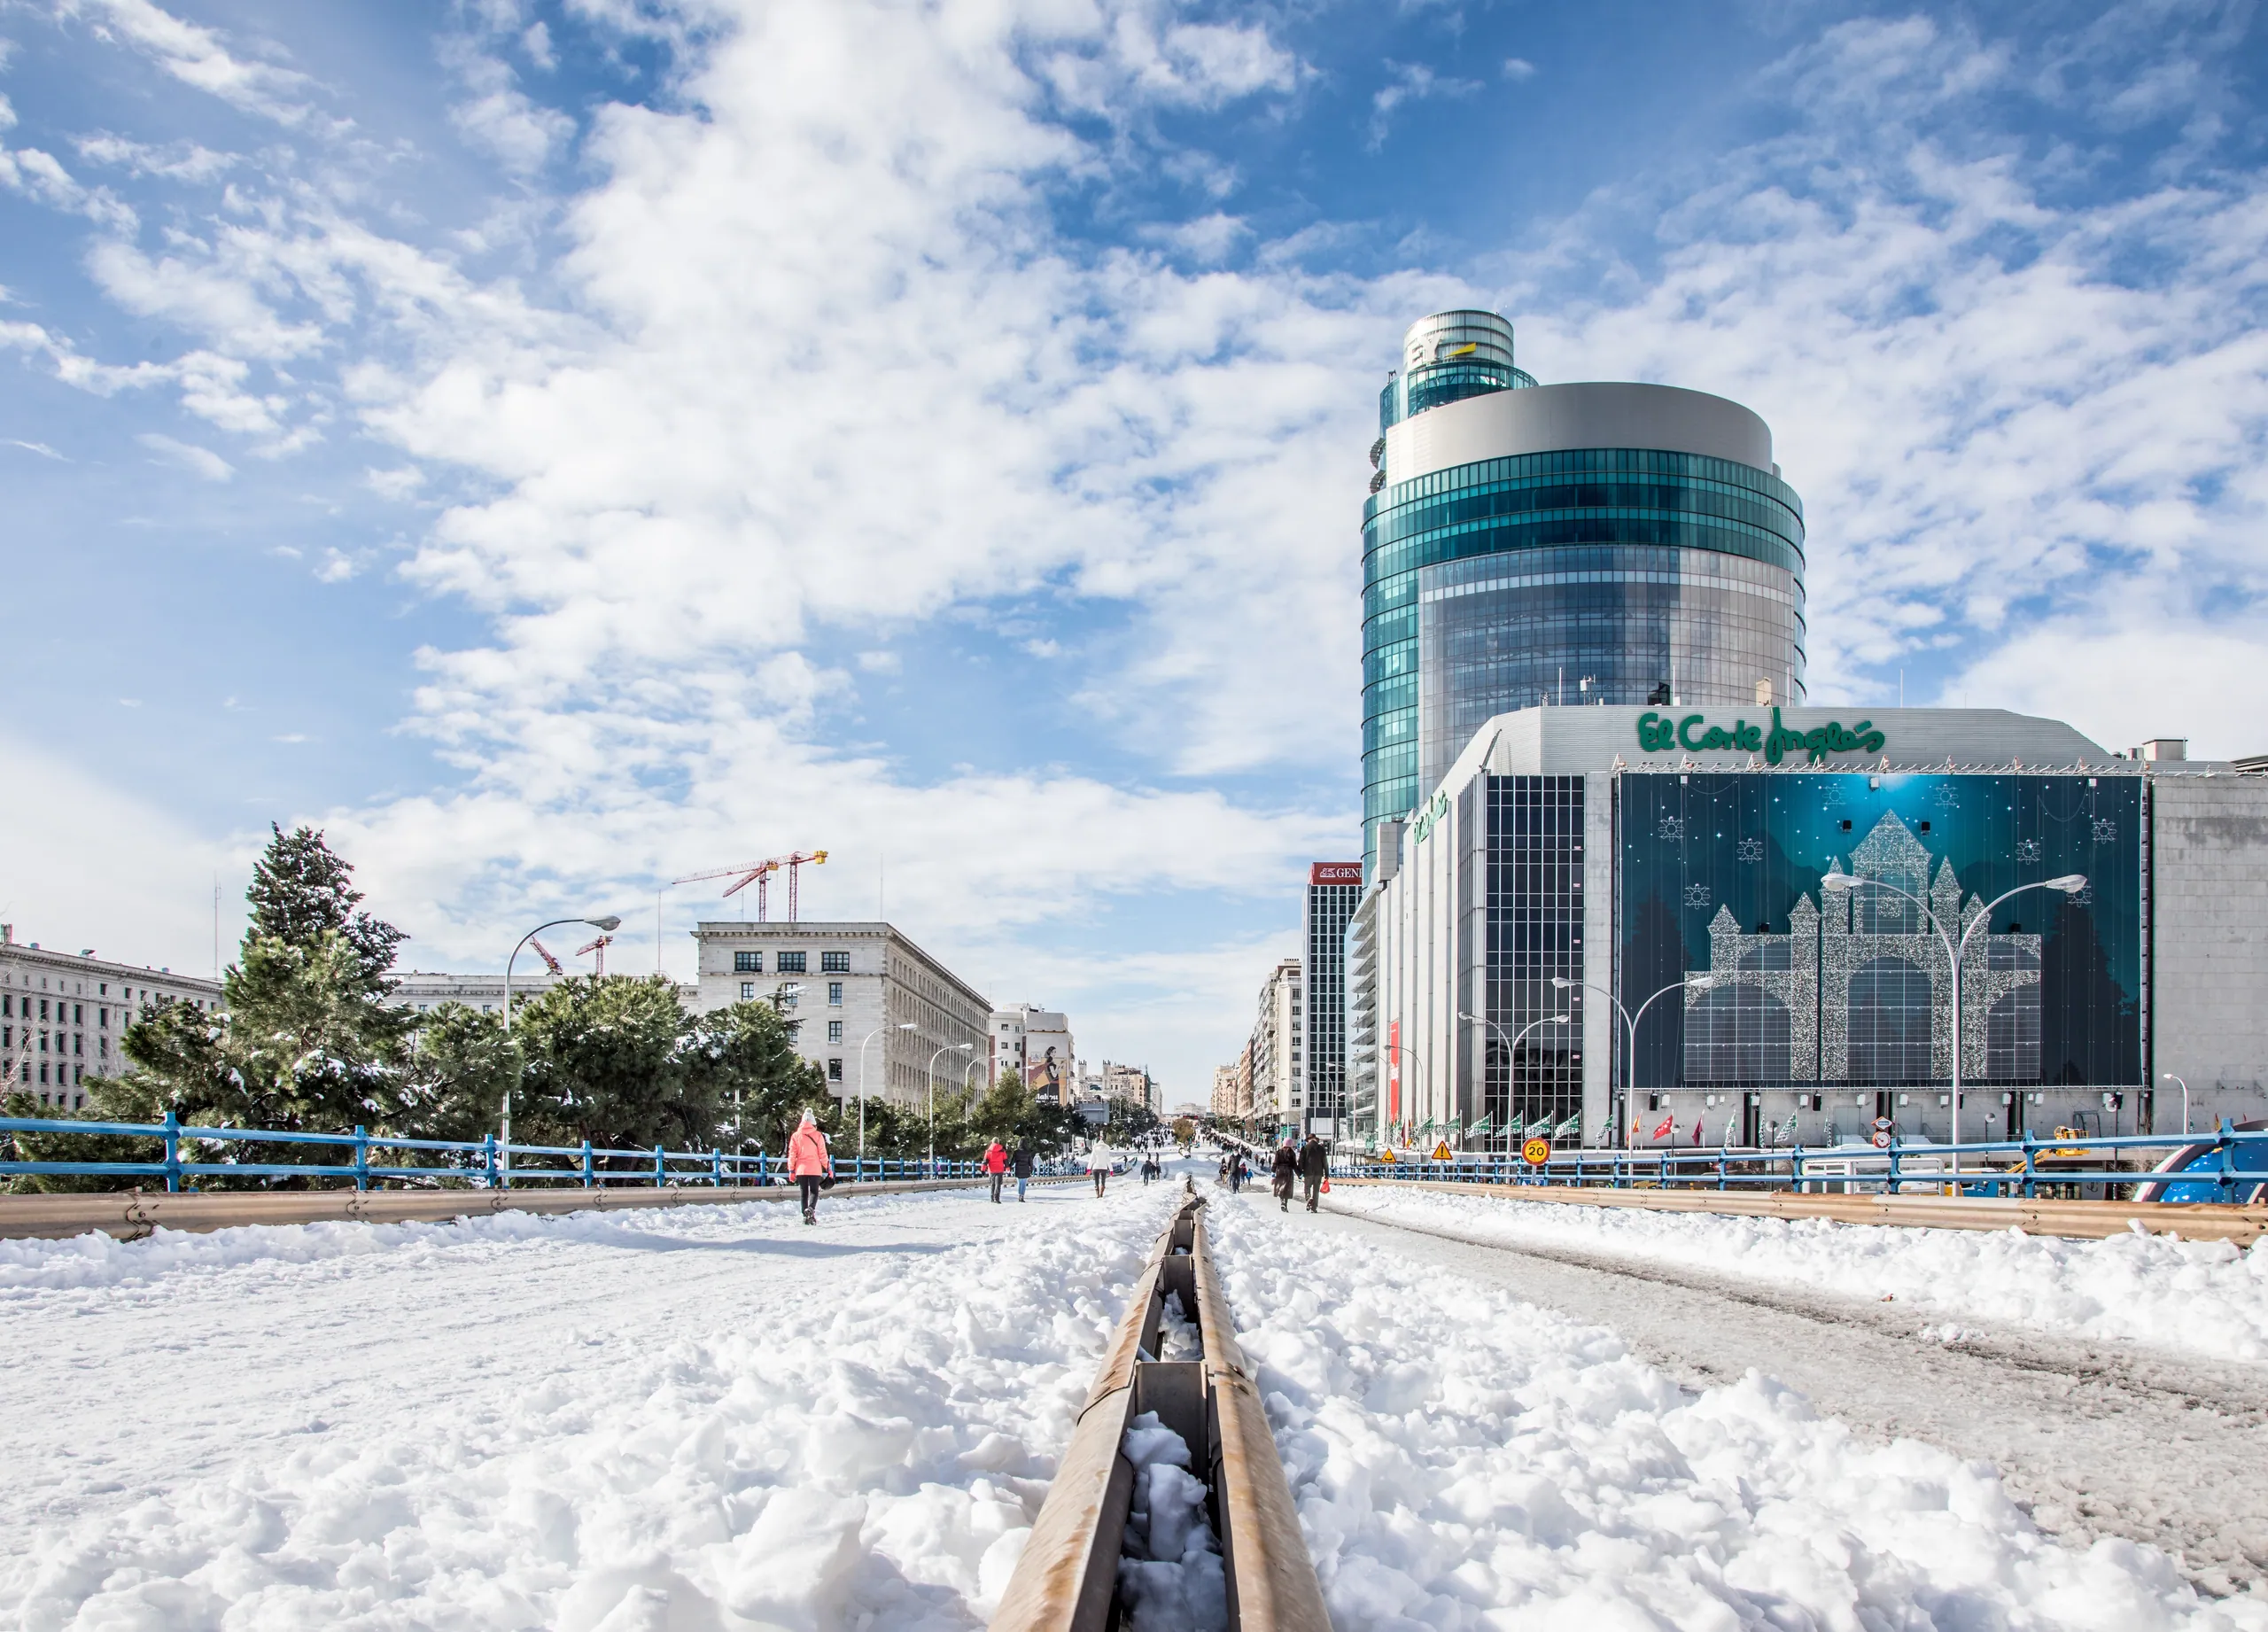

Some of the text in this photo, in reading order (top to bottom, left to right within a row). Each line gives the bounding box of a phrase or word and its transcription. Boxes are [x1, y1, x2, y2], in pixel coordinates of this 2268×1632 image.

[1408, 331, 1443, 369] EY
[1637, 706, 1885, 765] El Corte Inglés
[1528, 1146, 1544, 1156] 20
